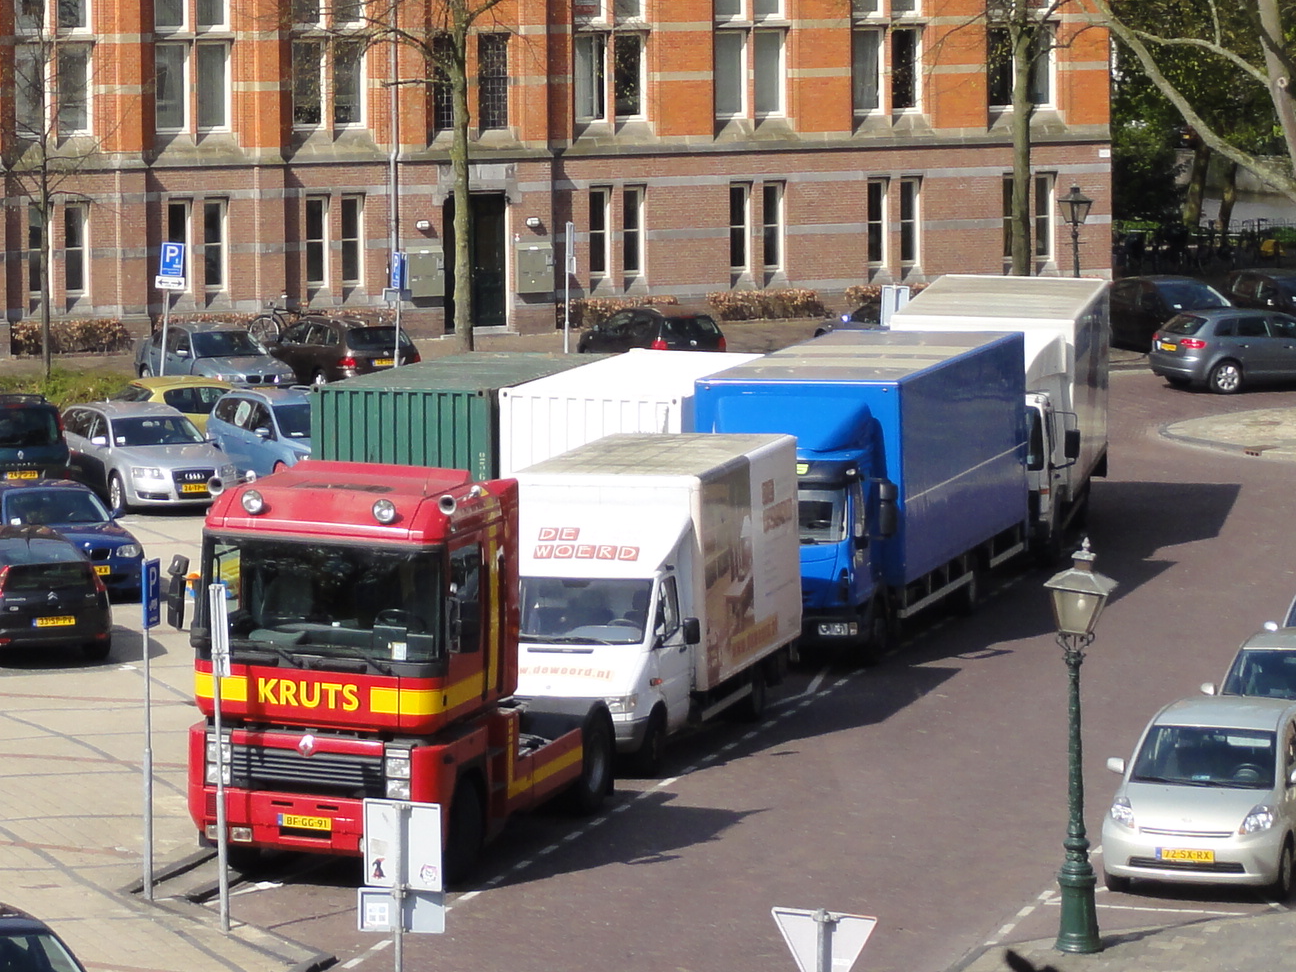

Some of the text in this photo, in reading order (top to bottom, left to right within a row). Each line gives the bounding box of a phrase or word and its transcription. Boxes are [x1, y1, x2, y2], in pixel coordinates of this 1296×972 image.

[165, 245, 179, 263] P
[539, 528, 577, 540] DE
[535, 545, 637, 559] WOERD
[149, 566, 157, 597] P
[258, 677, 360, 712] KRUTS
[286, 816, 327, 828] BF-GG-91
[1165, 849, 1209, 860] 72-SX-RX
